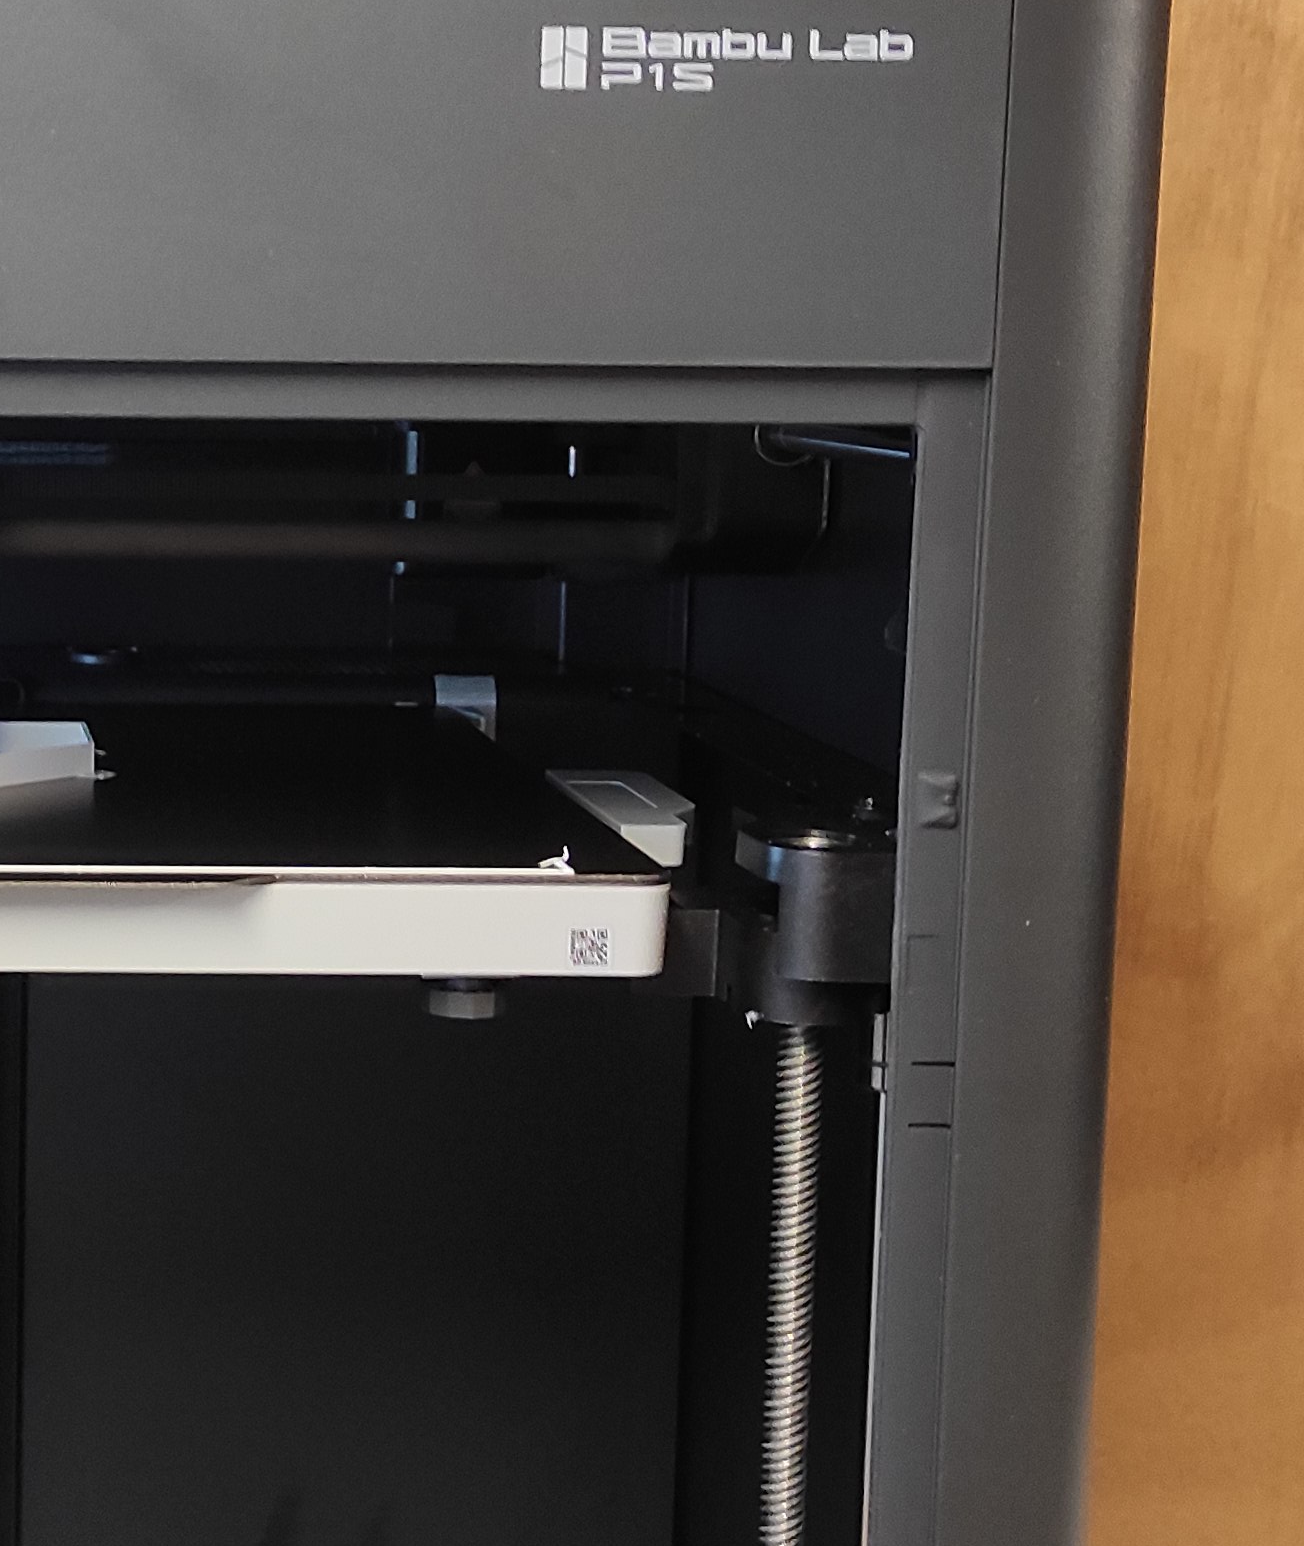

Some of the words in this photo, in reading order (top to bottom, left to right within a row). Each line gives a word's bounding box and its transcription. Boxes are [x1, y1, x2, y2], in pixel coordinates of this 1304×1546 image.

[601, 26, 793, 61] Bambu
[809, 28, 914, 62] Lab
[600, 61, 715, 92] P1S
